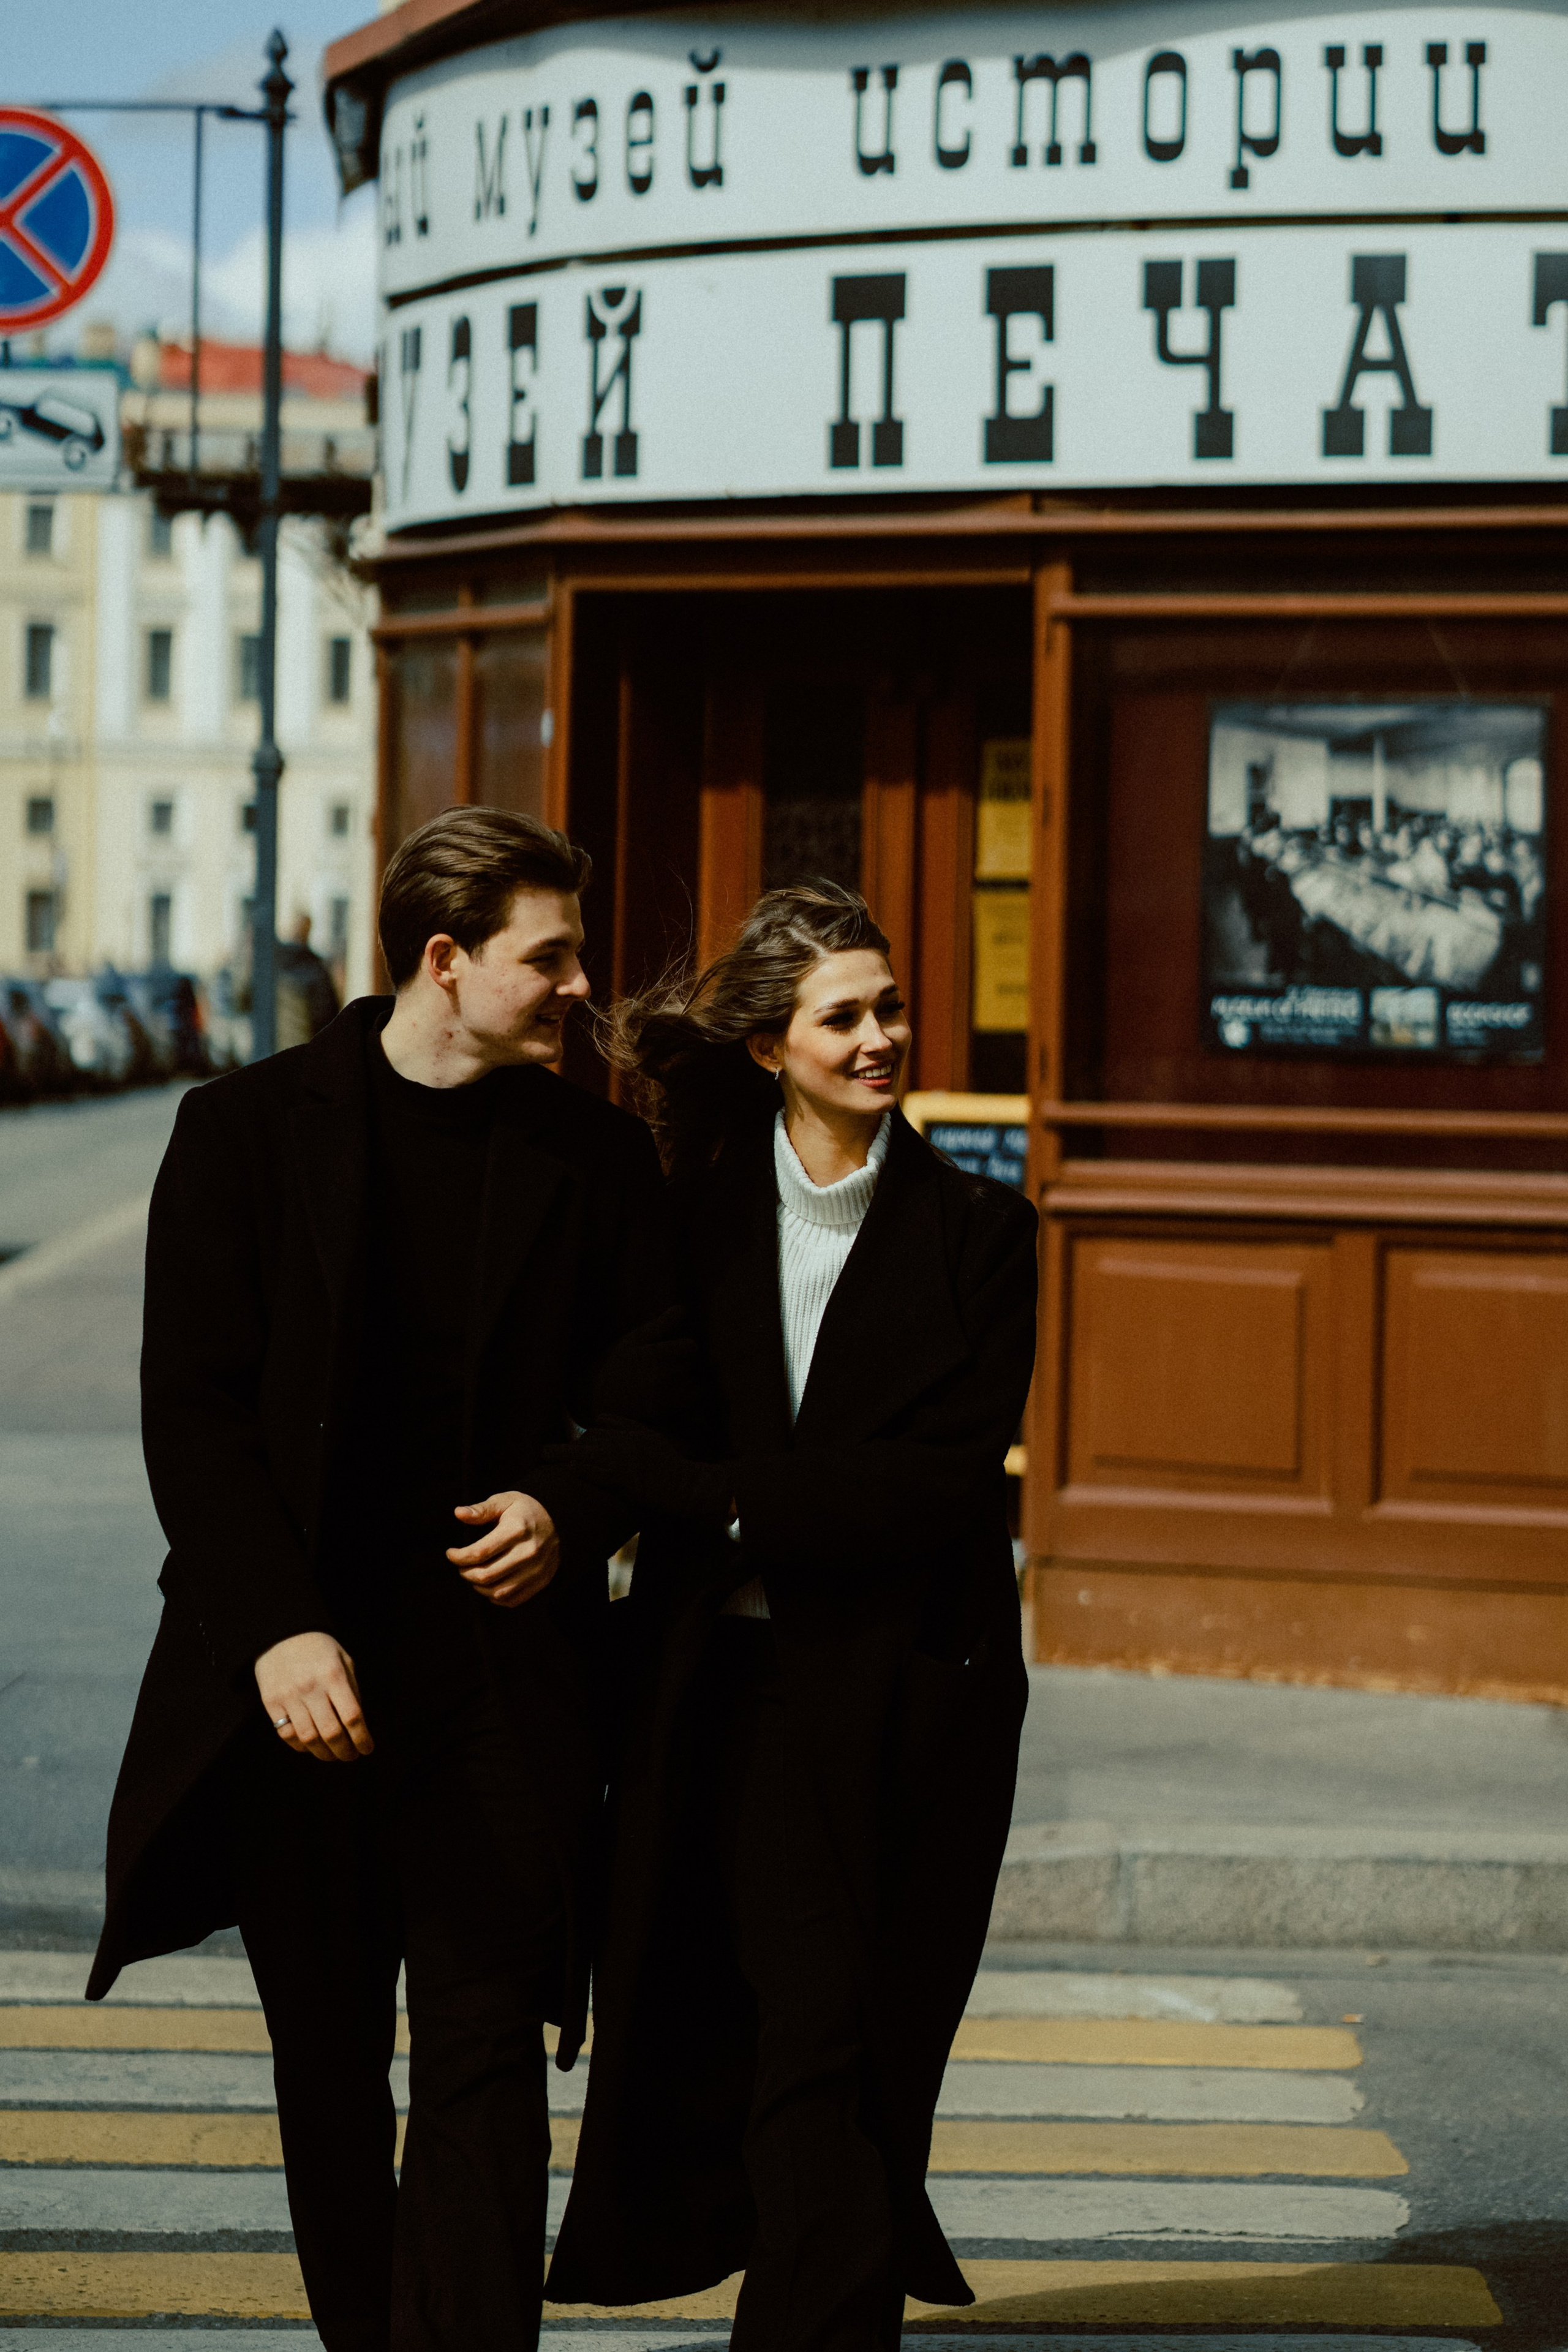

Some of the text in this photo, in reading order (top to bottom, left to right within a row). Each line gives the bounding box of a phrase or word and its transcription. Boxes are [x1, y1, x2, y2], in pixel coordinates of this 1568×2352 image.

[474, 47, 726, 237] музей
[851, 42, 1487, 189] истории
[381, 286, 641, 503] УЗЕЙ
